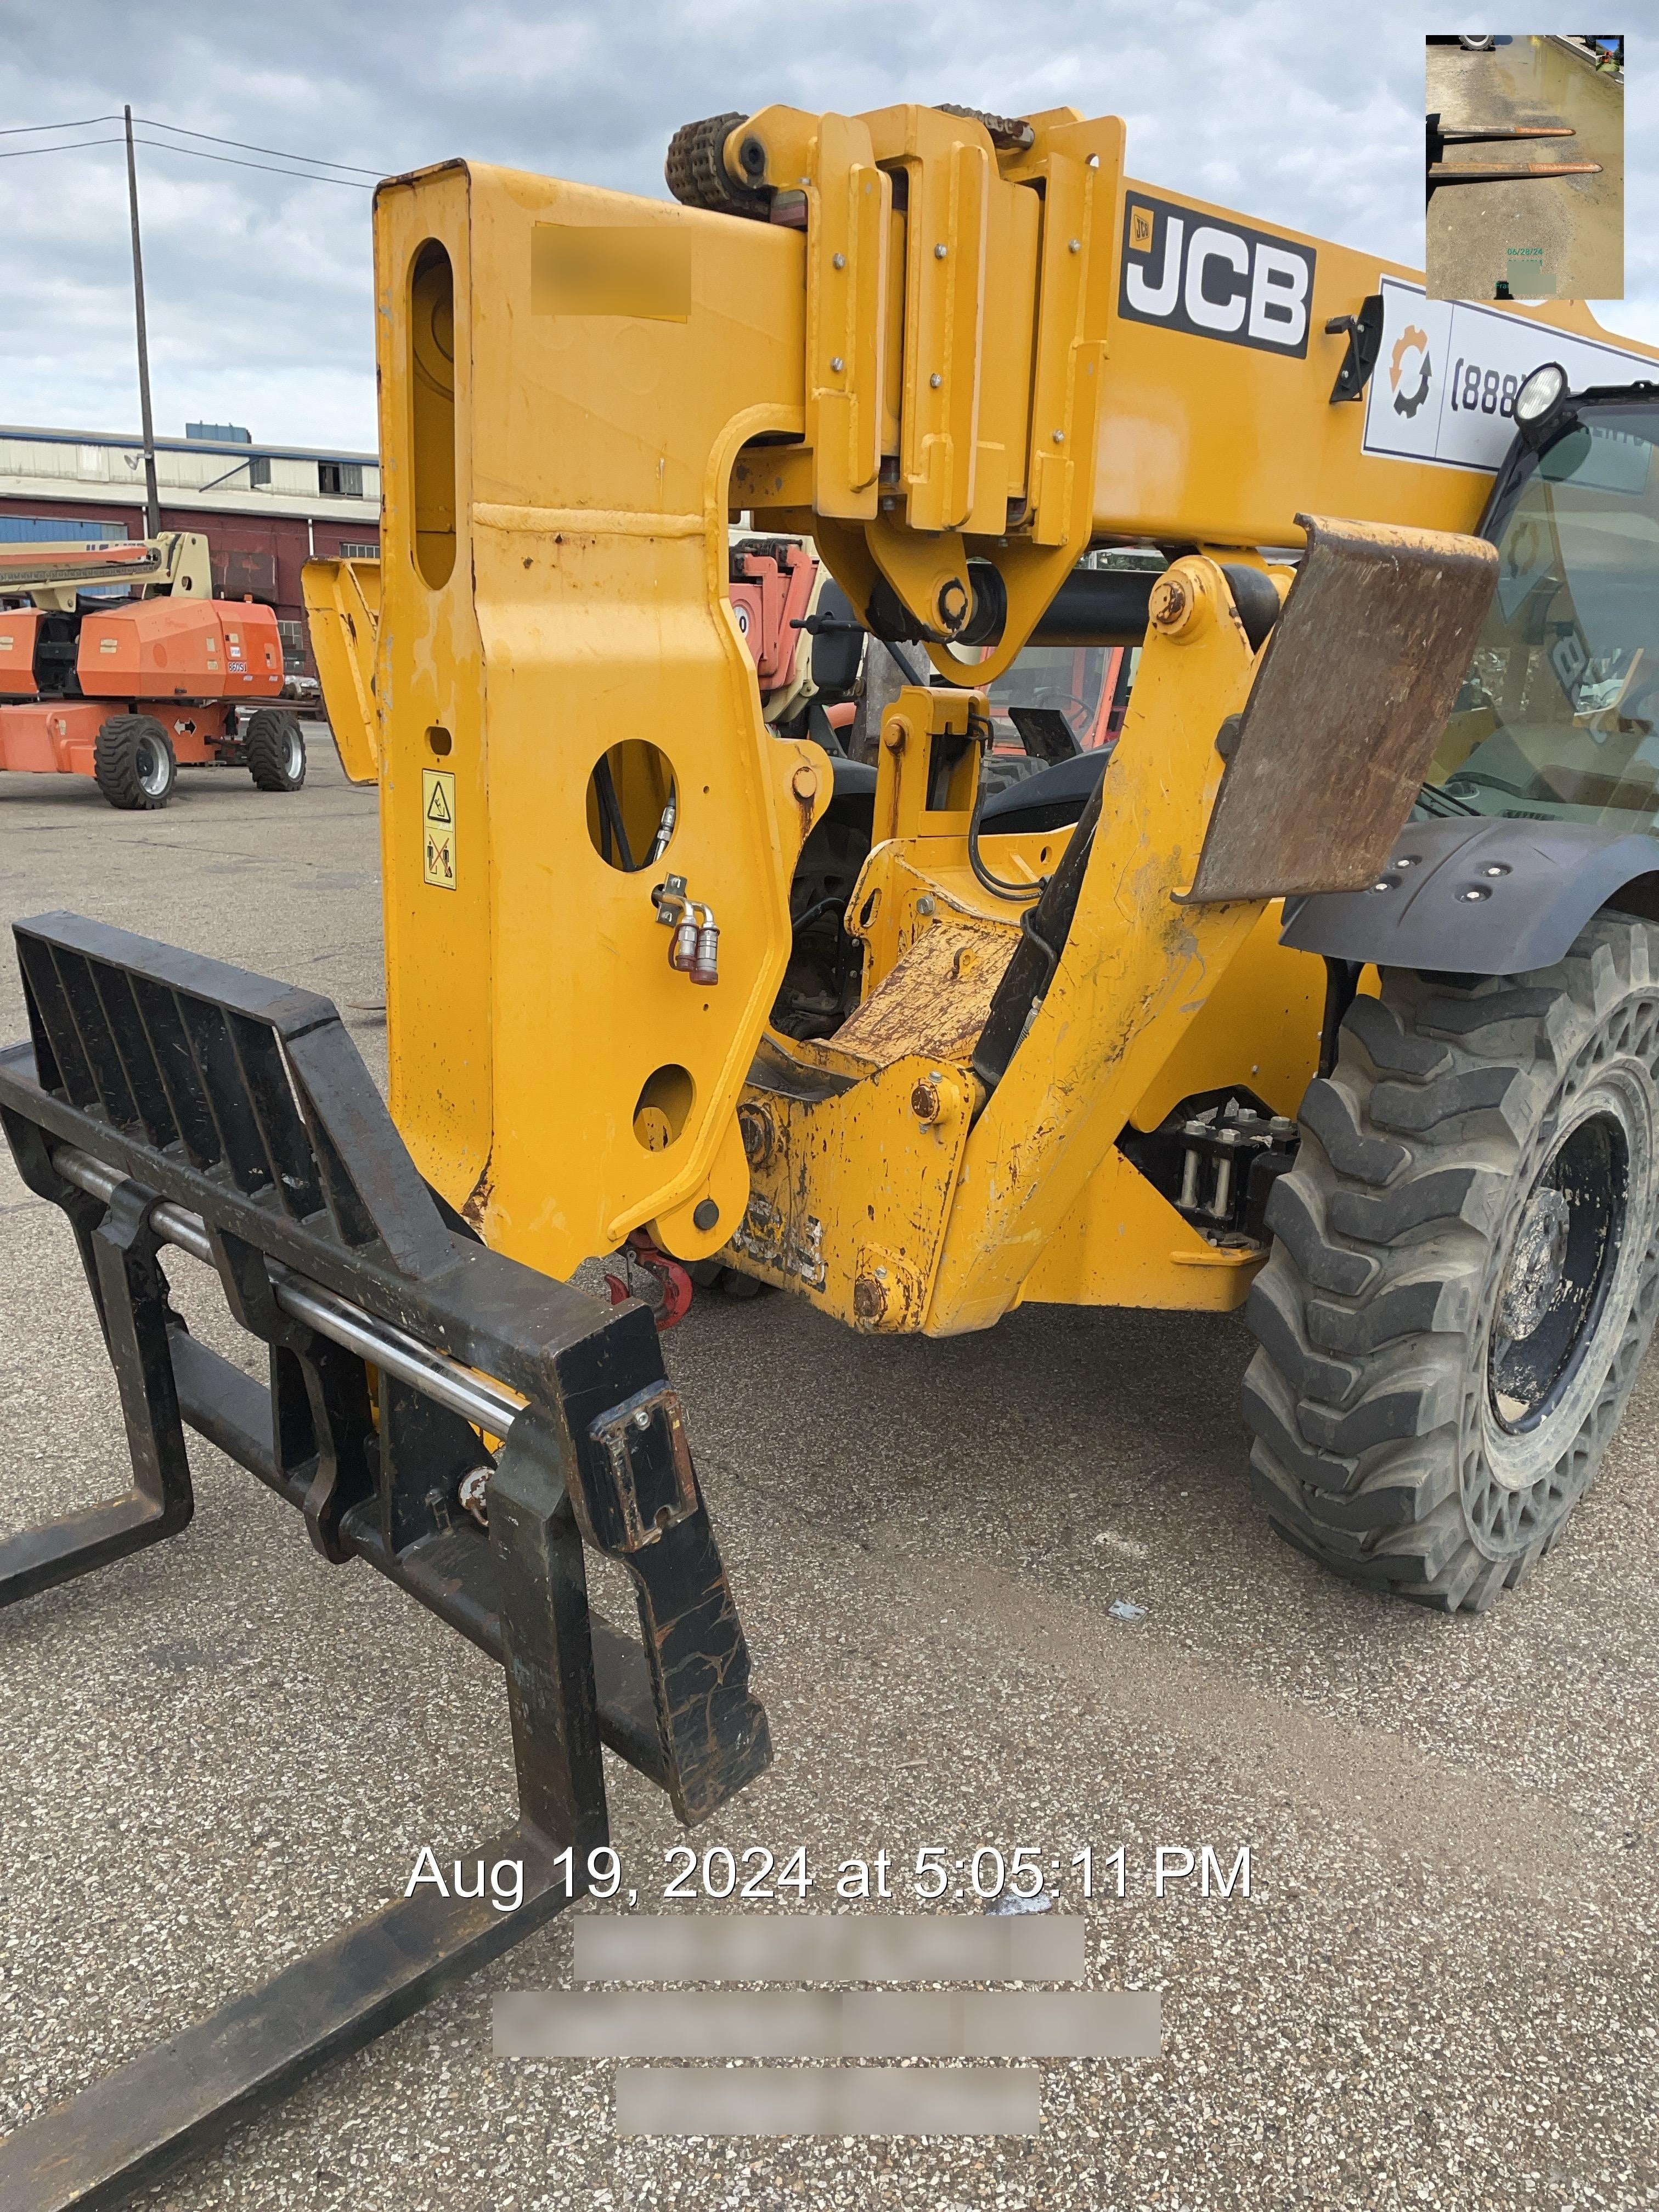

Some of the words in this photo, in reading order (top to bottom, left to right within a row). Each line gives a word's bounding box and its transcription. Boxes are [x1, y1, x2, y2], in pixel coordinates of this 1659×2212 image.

[1137, 218, 1149, 238] JCB
[1126, 216, 1308, 346] JCB
[1451, 357, 1527, 418] (888
